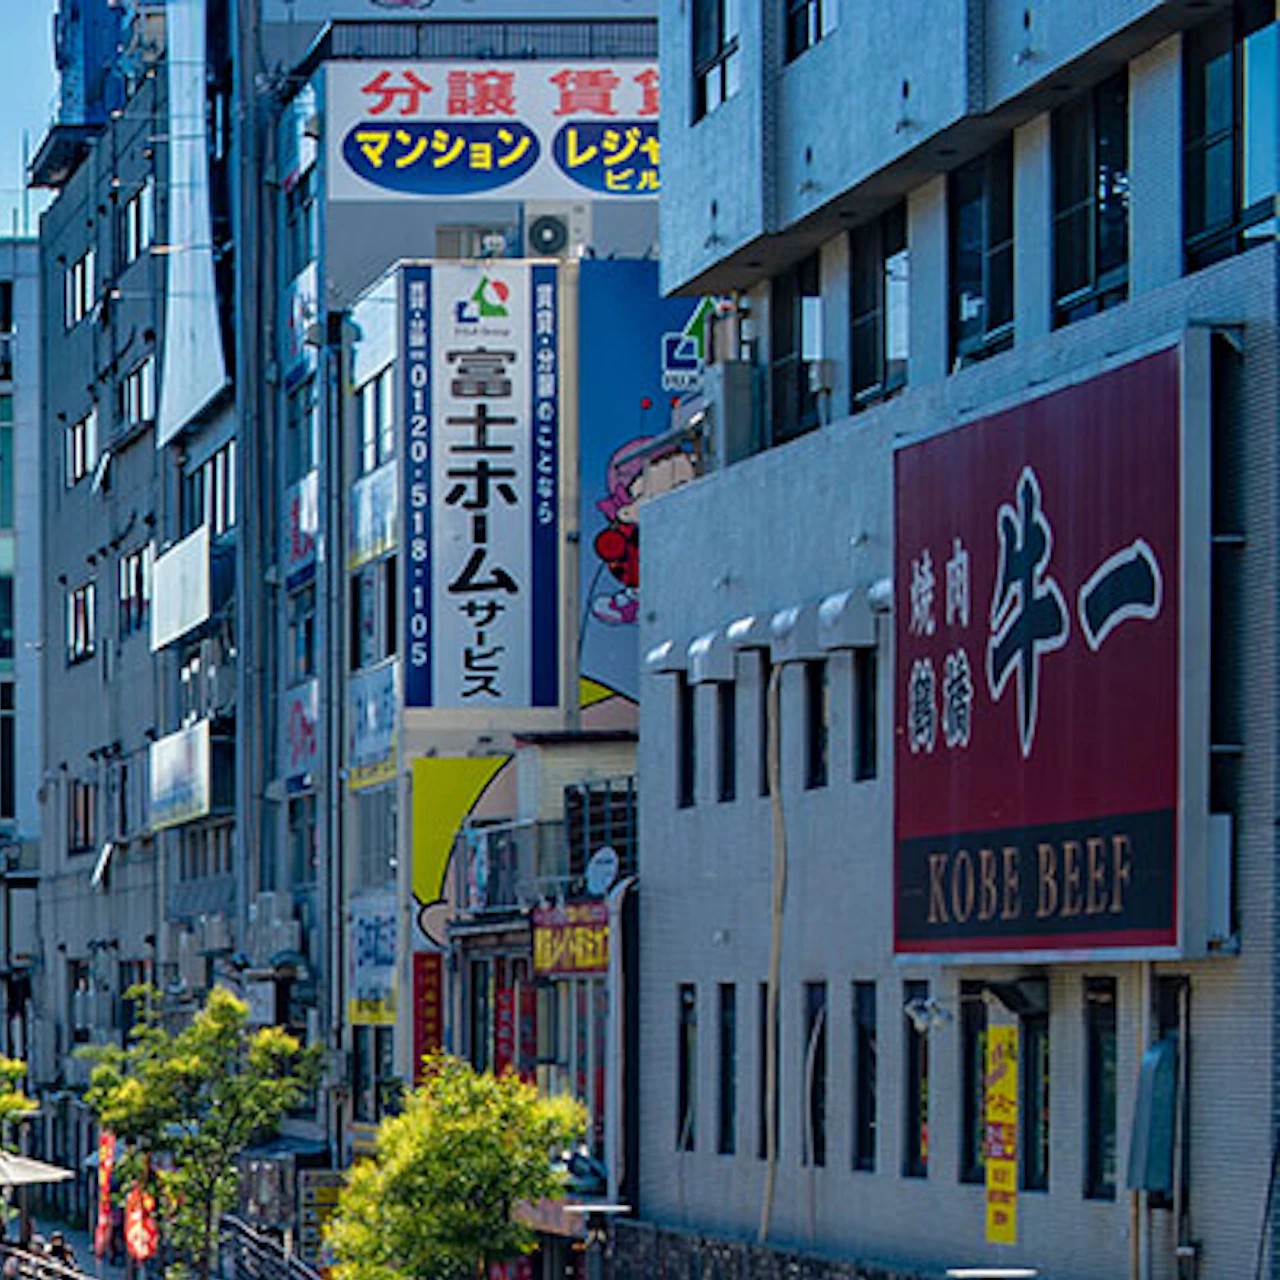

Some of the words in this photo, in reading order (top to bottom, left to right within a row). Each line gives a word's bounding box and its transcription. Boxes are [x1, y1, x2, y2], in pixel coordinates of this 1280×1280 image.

[360, 69, 517, 117] 分譲
[355, 128, 531, 171] マンション
[605, 169, 660, 191] ビル
[444, 346, 518, 698] 富士ホームサービス
[909, 537, 970, 636] 焼肉
[987, 466, 1162, 758] 牛一
[927, 845, 1020, 924] KOBE
[1038, 834, 1132, 915] BEEF
